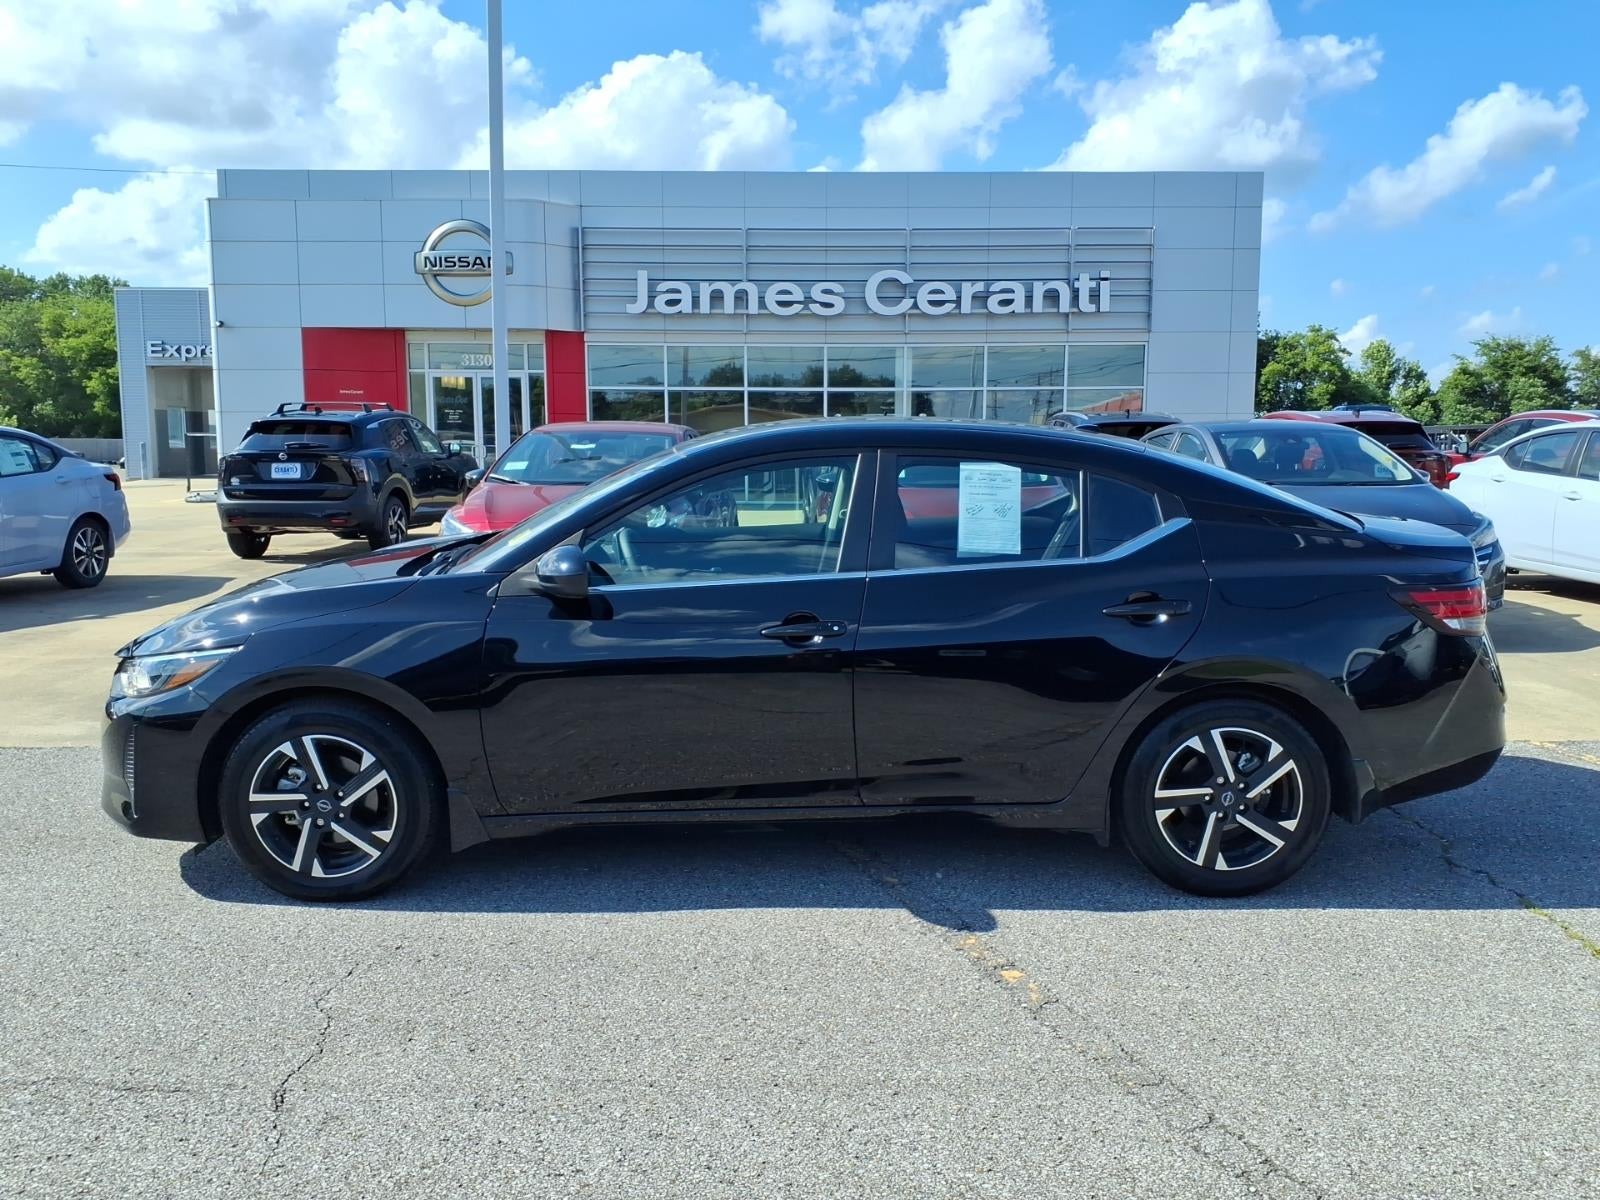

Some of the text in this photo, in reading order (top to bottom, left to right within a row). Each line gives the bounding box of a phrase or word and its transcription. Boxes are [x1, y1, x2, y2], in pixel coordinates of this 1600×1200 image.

[424, 256, 492, 268] NISSA
[626, 269, 1110, 315] James Ceranti
[461, 353, 493, 366] 3130
